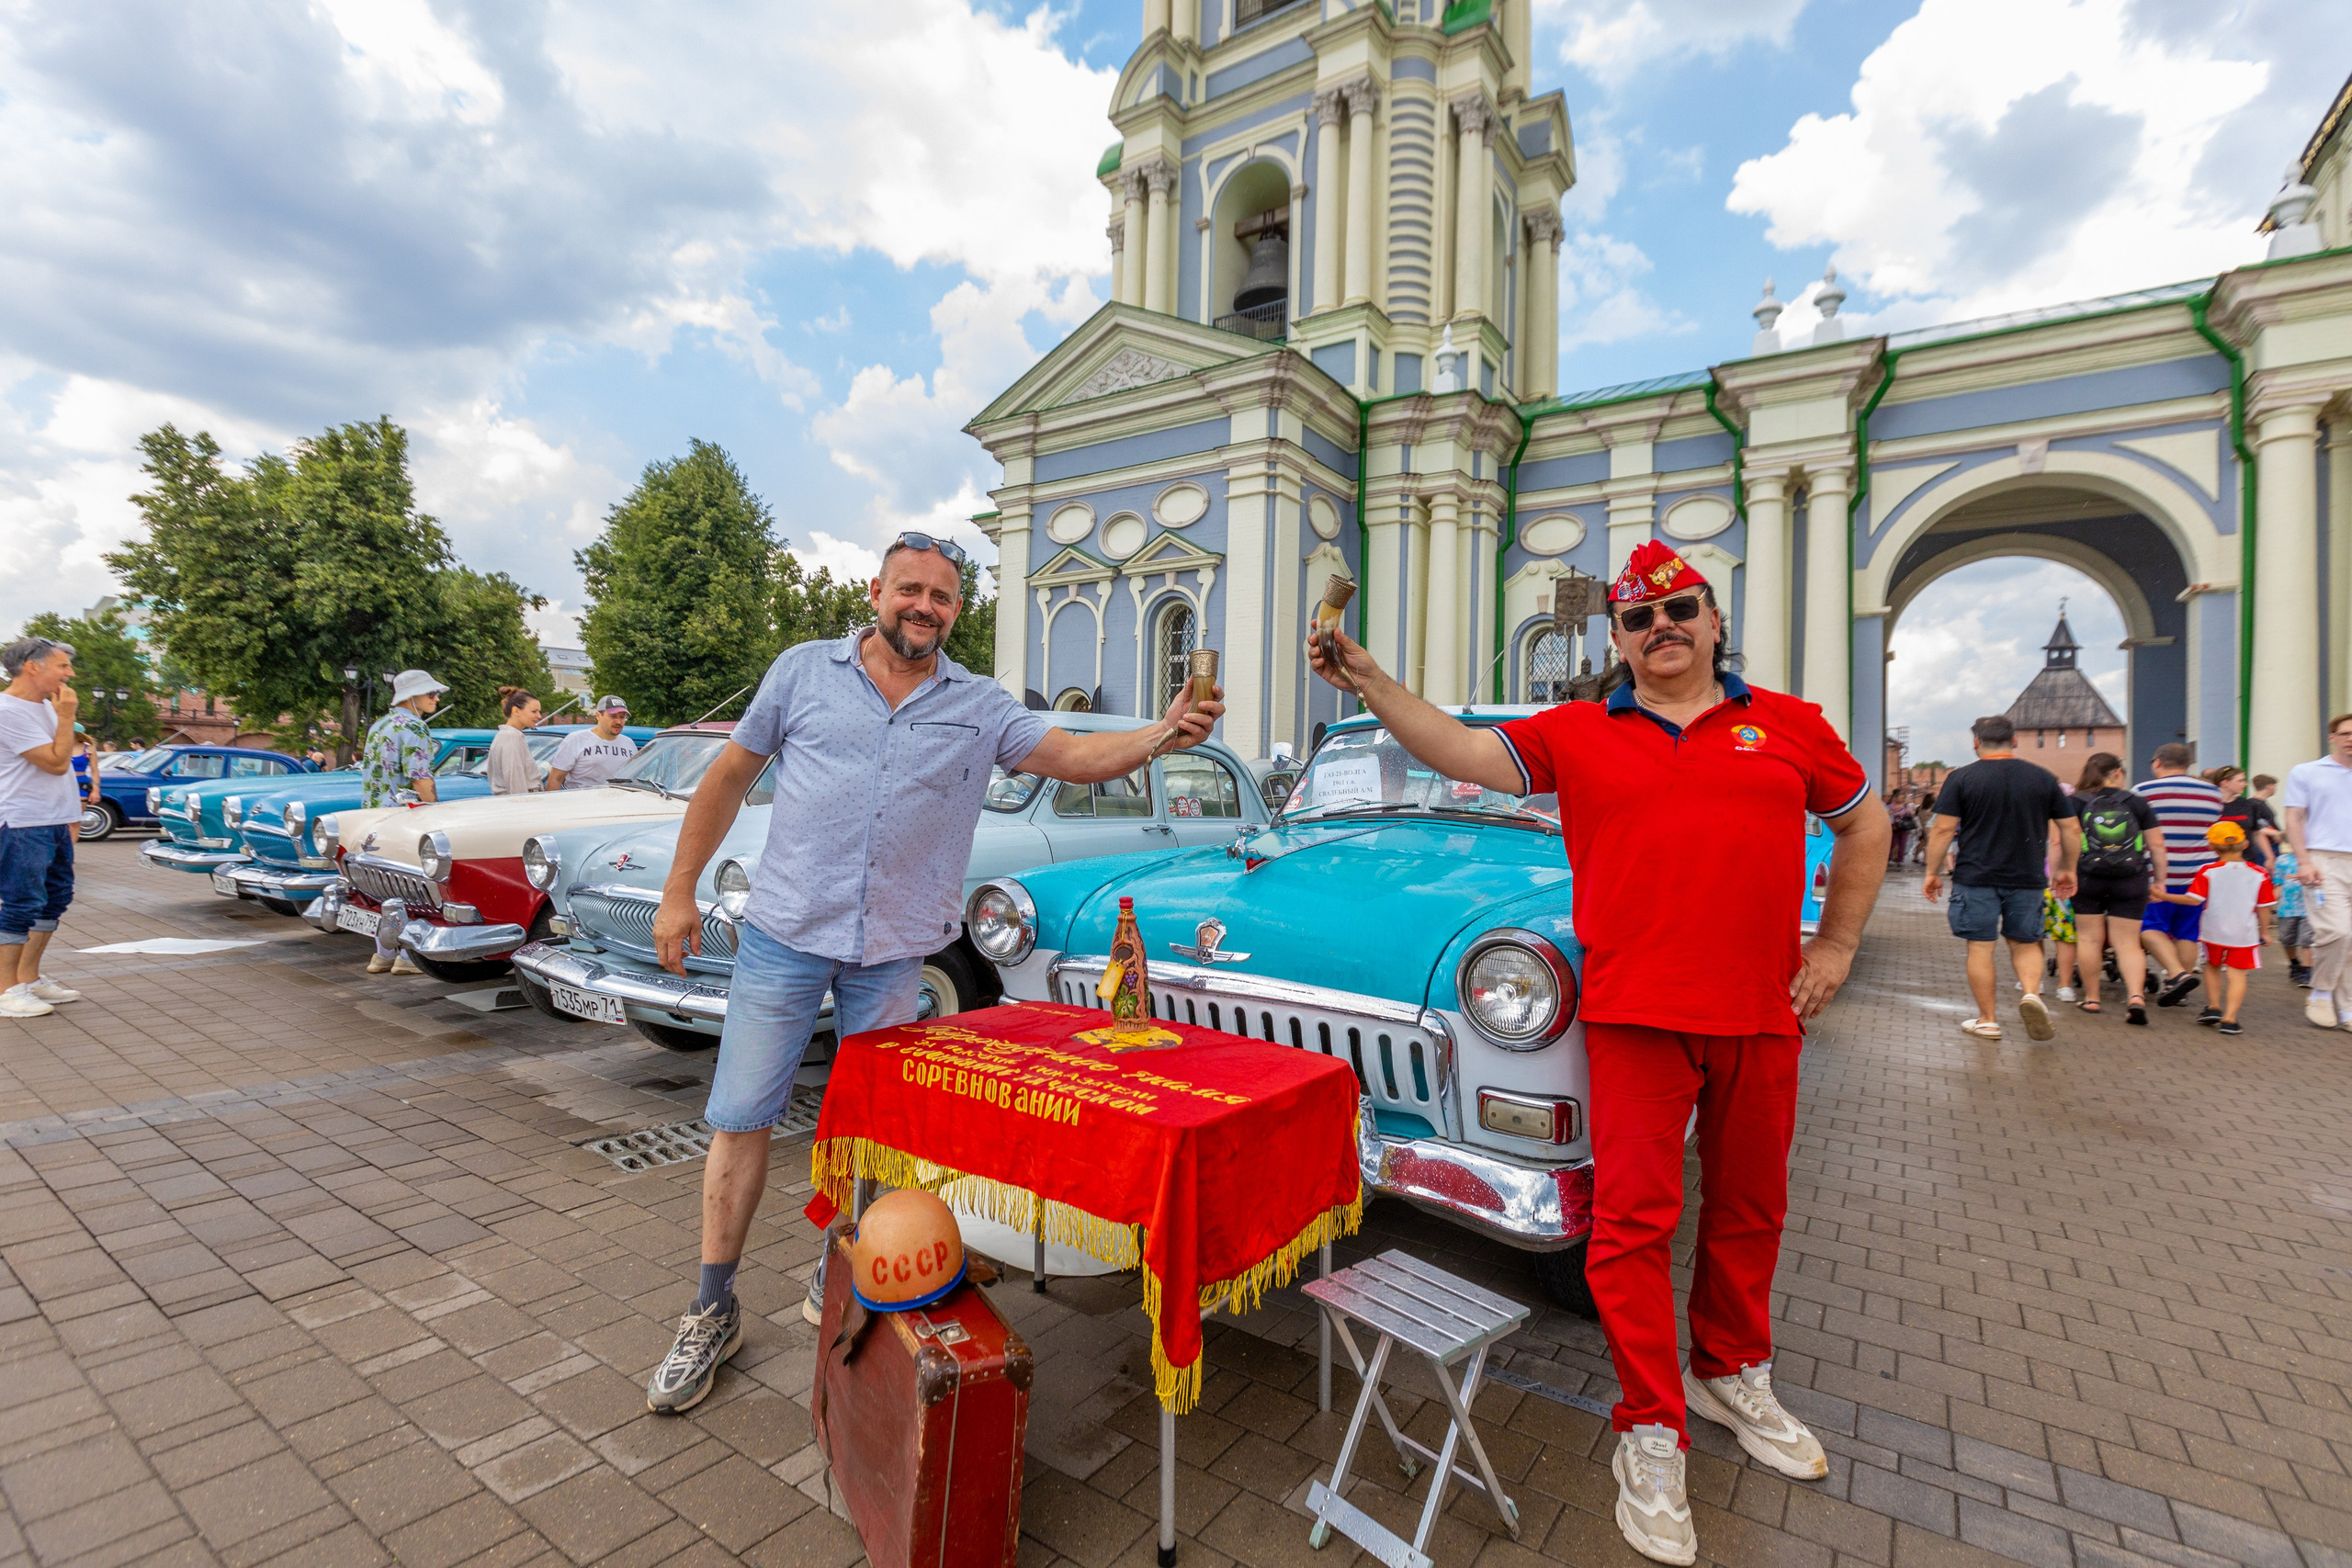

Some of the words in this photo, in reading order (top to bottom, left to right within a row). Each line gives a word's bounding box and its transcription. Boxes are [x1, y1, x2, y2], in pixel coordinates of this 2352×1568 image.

[583, 745, 634, 758] NATURE
[1324, 769, 1367, 779] ГАЗ-21-ВОЛГА
[1318, 787, 1359, 797] СВАДЕБНЫЙ
[601, 997, 618, 1015] 71
[604, 1013, 616, 1021] RUS
[902, 1058, 1081, 1126] СОРЕВНОВАНИИ
[872, 1240, 948, 1285] СССР
